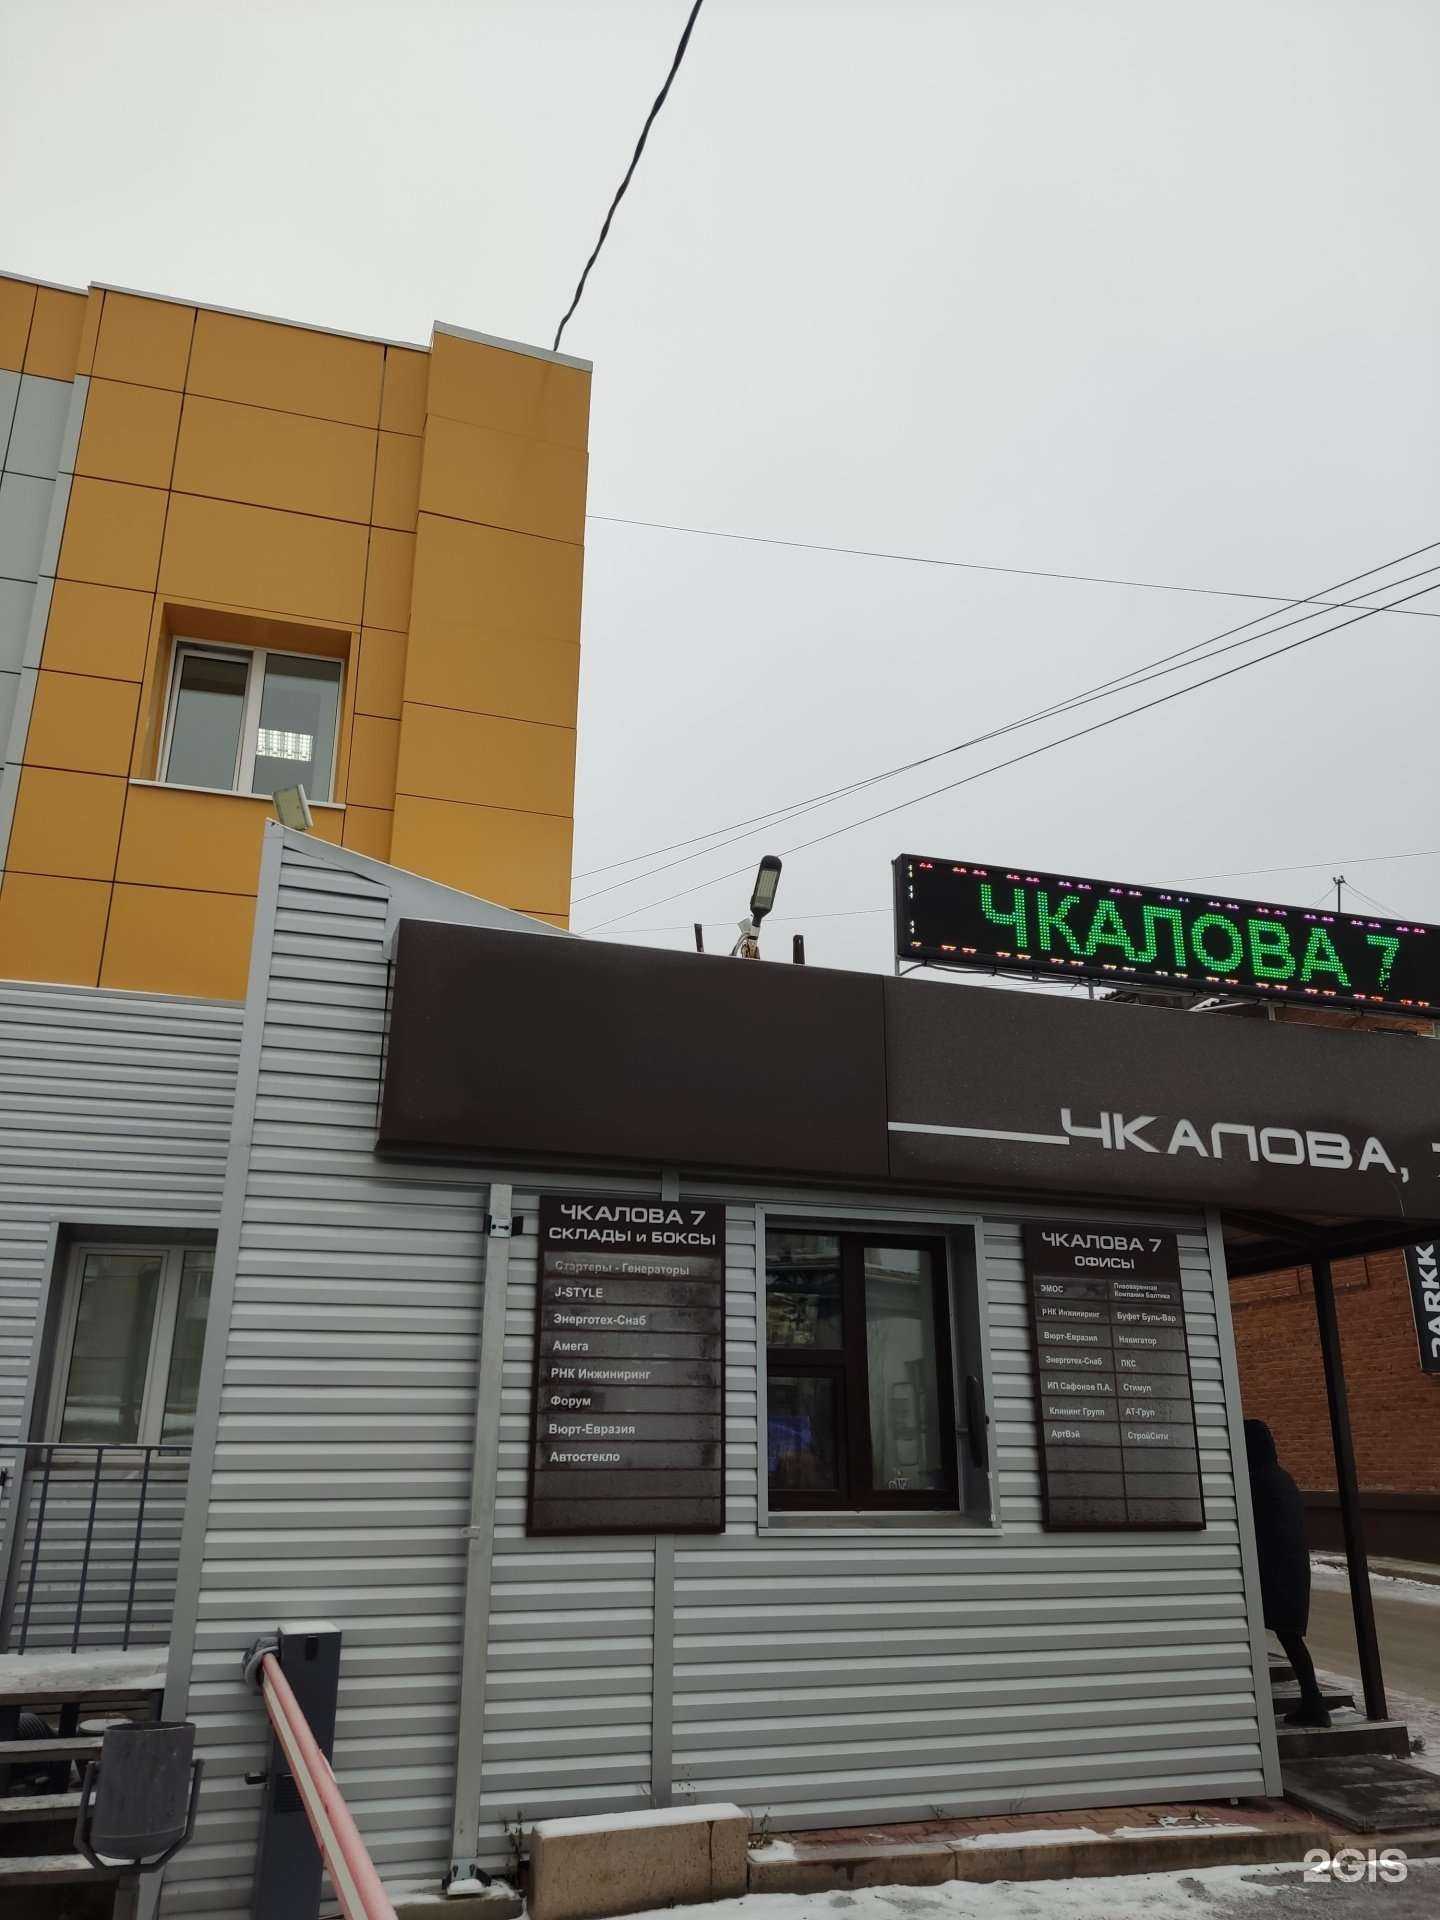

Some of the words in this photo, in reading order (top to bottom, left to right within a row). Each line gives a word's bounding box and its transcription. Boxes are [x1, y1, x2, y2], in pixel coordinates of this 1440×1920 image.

[980, 882, 1352, 987] ЧКАЛОВА
[1366, 934, 1401, 991] 7
[1060, 1107, 1410, 1183] ЧКАЛОВА,
[560, 1203, 684, 1225] ЧКАЛОВА
[690, 1210, 706, 1226] 7
[549, 1227, 631, 1244] СКЛАДЫ
[651, 1231, 716, 1245] БОКСЫ
[1041, 1231, 1145, 1252] ЧКАЛОВА
[1149, 1239, 1162, 1253] 7
[555, 1260, 612, 1274] Стартеры
[622, 1263, 690, 1277] Генераторы
[1074, 1255, 1135, 1269] ОФИСЫ
[554, 1287, 604, 1299] J-STYLE
[553, 1313, 647, 1326] Энерготех-Снаб
[1117, 1312, 1140, 1321] Буфет
[1044, 1332, 1098, 1342] Вюрт-Евразия
[552, 1340, 589, 1351] Амега
[1045, 1355, 1102, 1366] Энерготех-Снаб
[551, 1368, 575, 1379] РНК
[578, 1369, 651, 1381] Инжиниринг
[550, 1395, 591, 1409] Форум
[549, 1423, 636, 1437] Вюрт-Евразия
[550, 1451, 621, 1463] Автостекло
